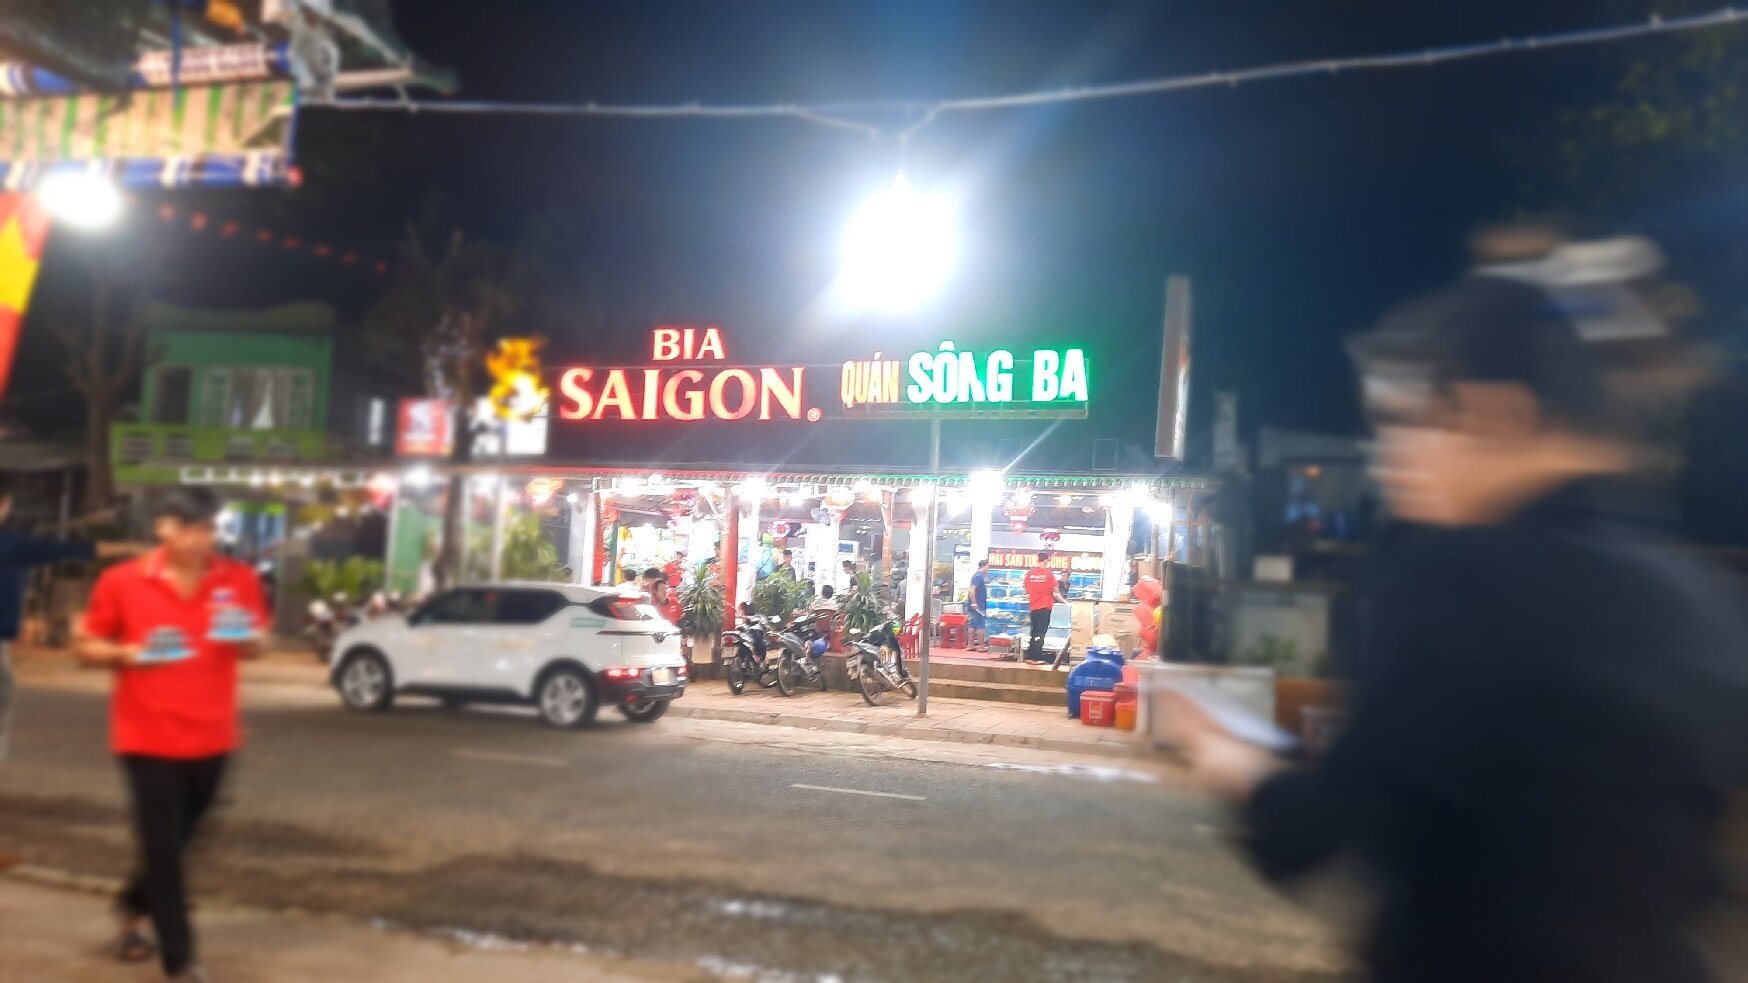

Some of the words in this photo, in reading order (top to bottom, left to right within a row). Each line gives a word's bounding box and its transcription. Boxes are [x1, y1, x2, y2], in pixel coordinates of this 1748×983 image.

[652, 328, 726, 361] BIA
[559, 367, 806, 421] SAIGON
[841, 351, 900, 408] QUÁN
[907, 340, 1014, 404] SÔNG
[1032, 348, 1089, 402] BA
